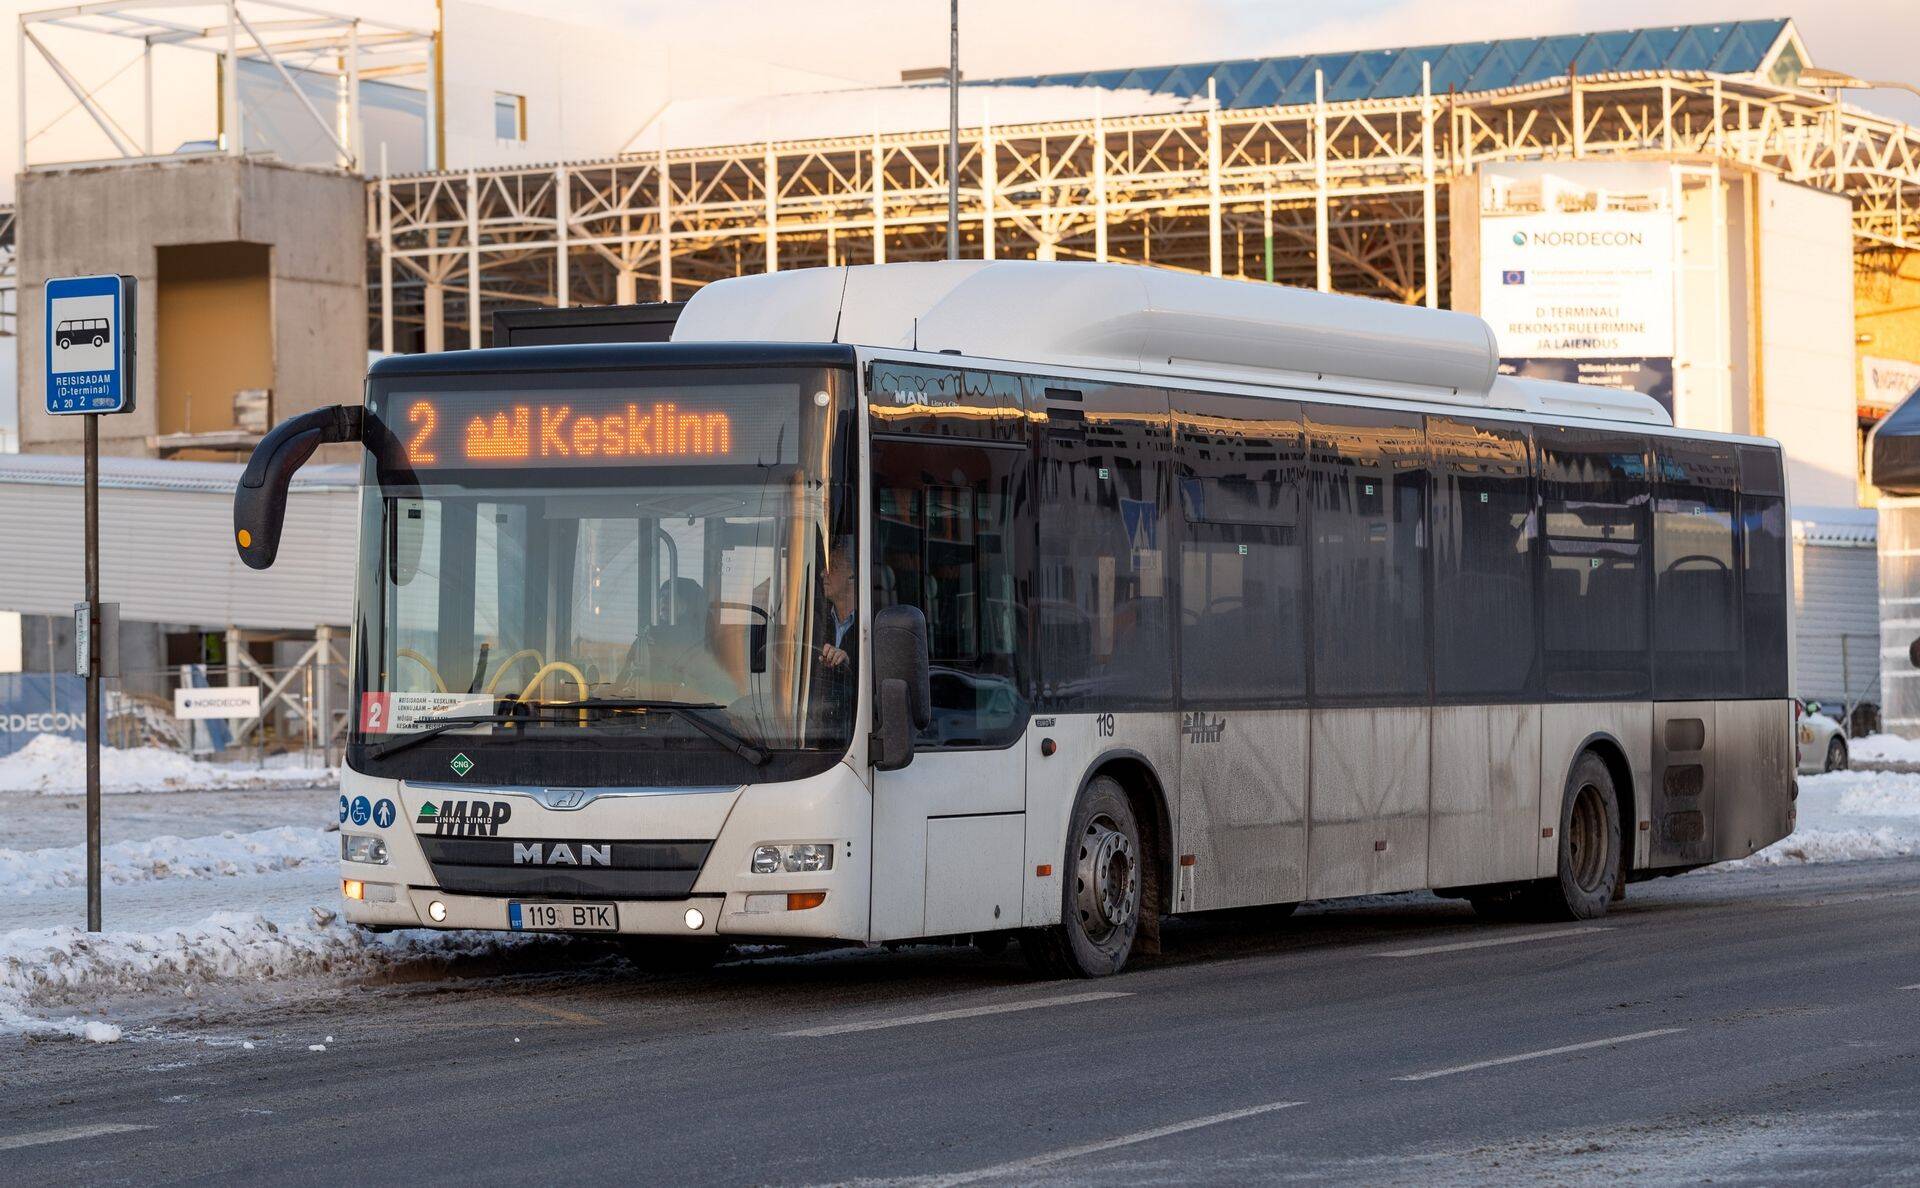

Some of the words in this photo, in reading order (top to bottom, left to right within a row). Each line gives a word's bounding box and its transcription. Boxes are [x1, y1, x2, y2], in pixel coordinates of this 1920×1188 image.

[1534, 231, 1642, 246] NORDECON
[1509, 323, 1646, 334] REKONSTRUEERIMINE
[1555, 338, 1619, 349] LAIENDUS
[56, 374, 110, 386] REISISADAM
[57, 384, 110, 398] (D-terminal)
[894, 390, 929, 406] MAN
[52, 400, 58, 409] A
[64, 399, 74, 408] 20
[80, 396, 86, 406] 2
[409, 402, 435, 463] 2
[541, 403, 730, 455] Kesklinn
[368, 702, 382, 727] 2
[1097, 714, 1115, 737] 119
[453, 761, 469, 769] CNG
[434, 816, 460, 824] LINNA
[466, 816, 492, 824] LIINID
[436, 800, 511, 836] MRP
[513, 842, 611, 866] MAN
[529, 906, 556, 926] 119
[573, 906, 610, 926] BTK
